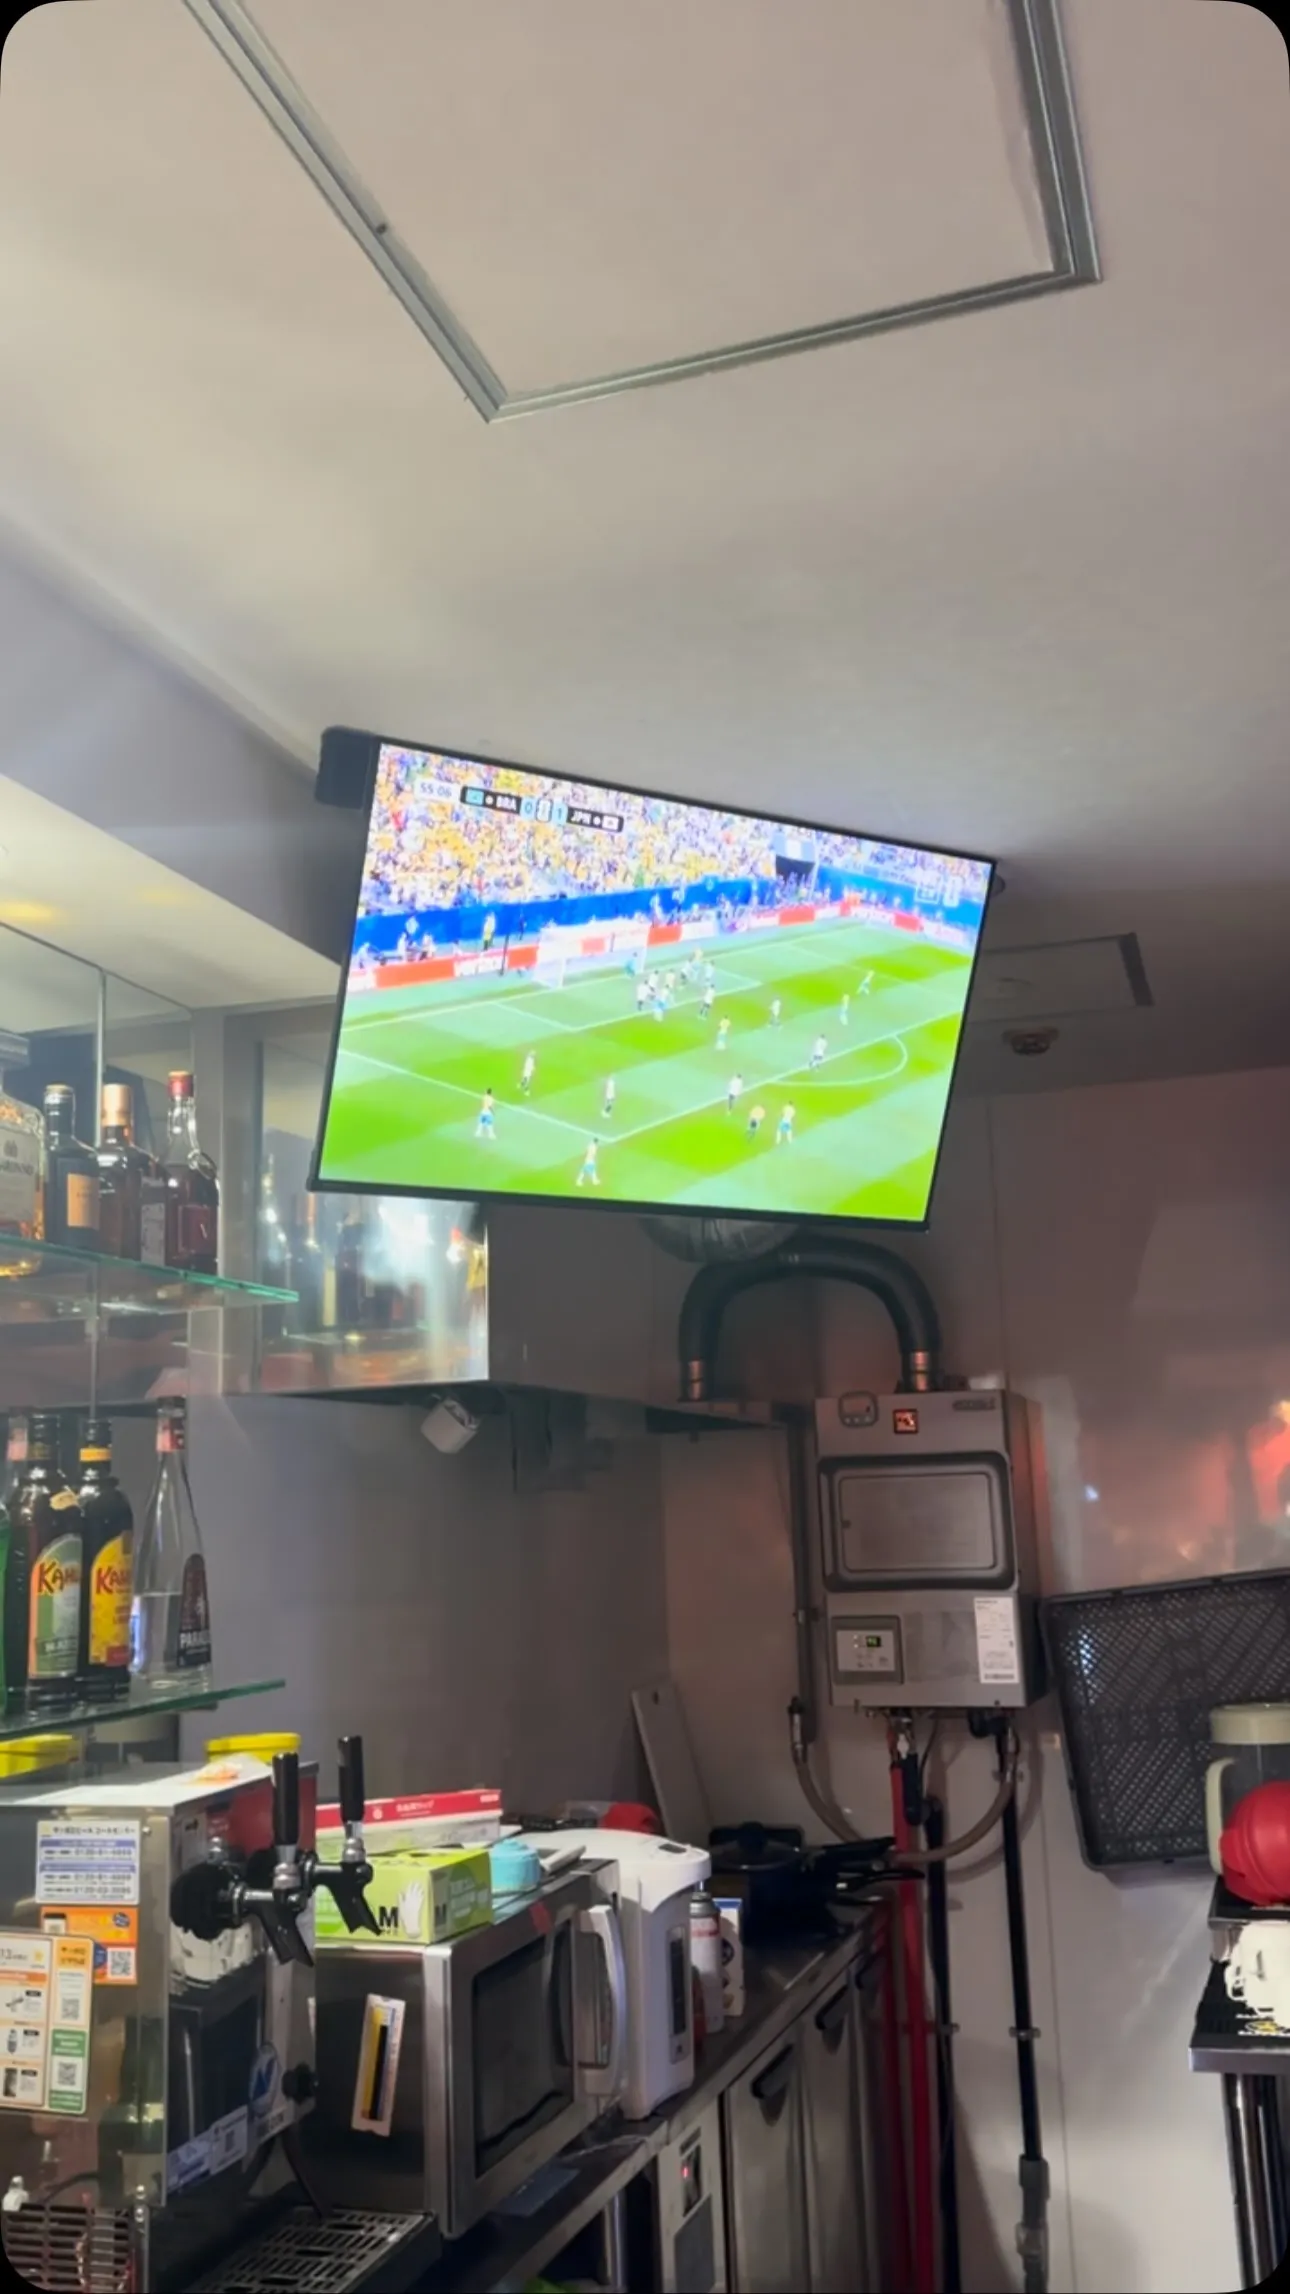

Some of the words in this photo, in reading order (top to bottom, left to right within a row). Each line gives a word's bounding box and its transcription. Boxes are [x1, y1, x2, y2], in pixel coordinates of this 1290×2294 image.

[496, 796, 517, 812] BRA
[523, 801, 533, 814] 0
[570, 810, 592, 825] JPN
[379, 1906, 399, 1928] M
